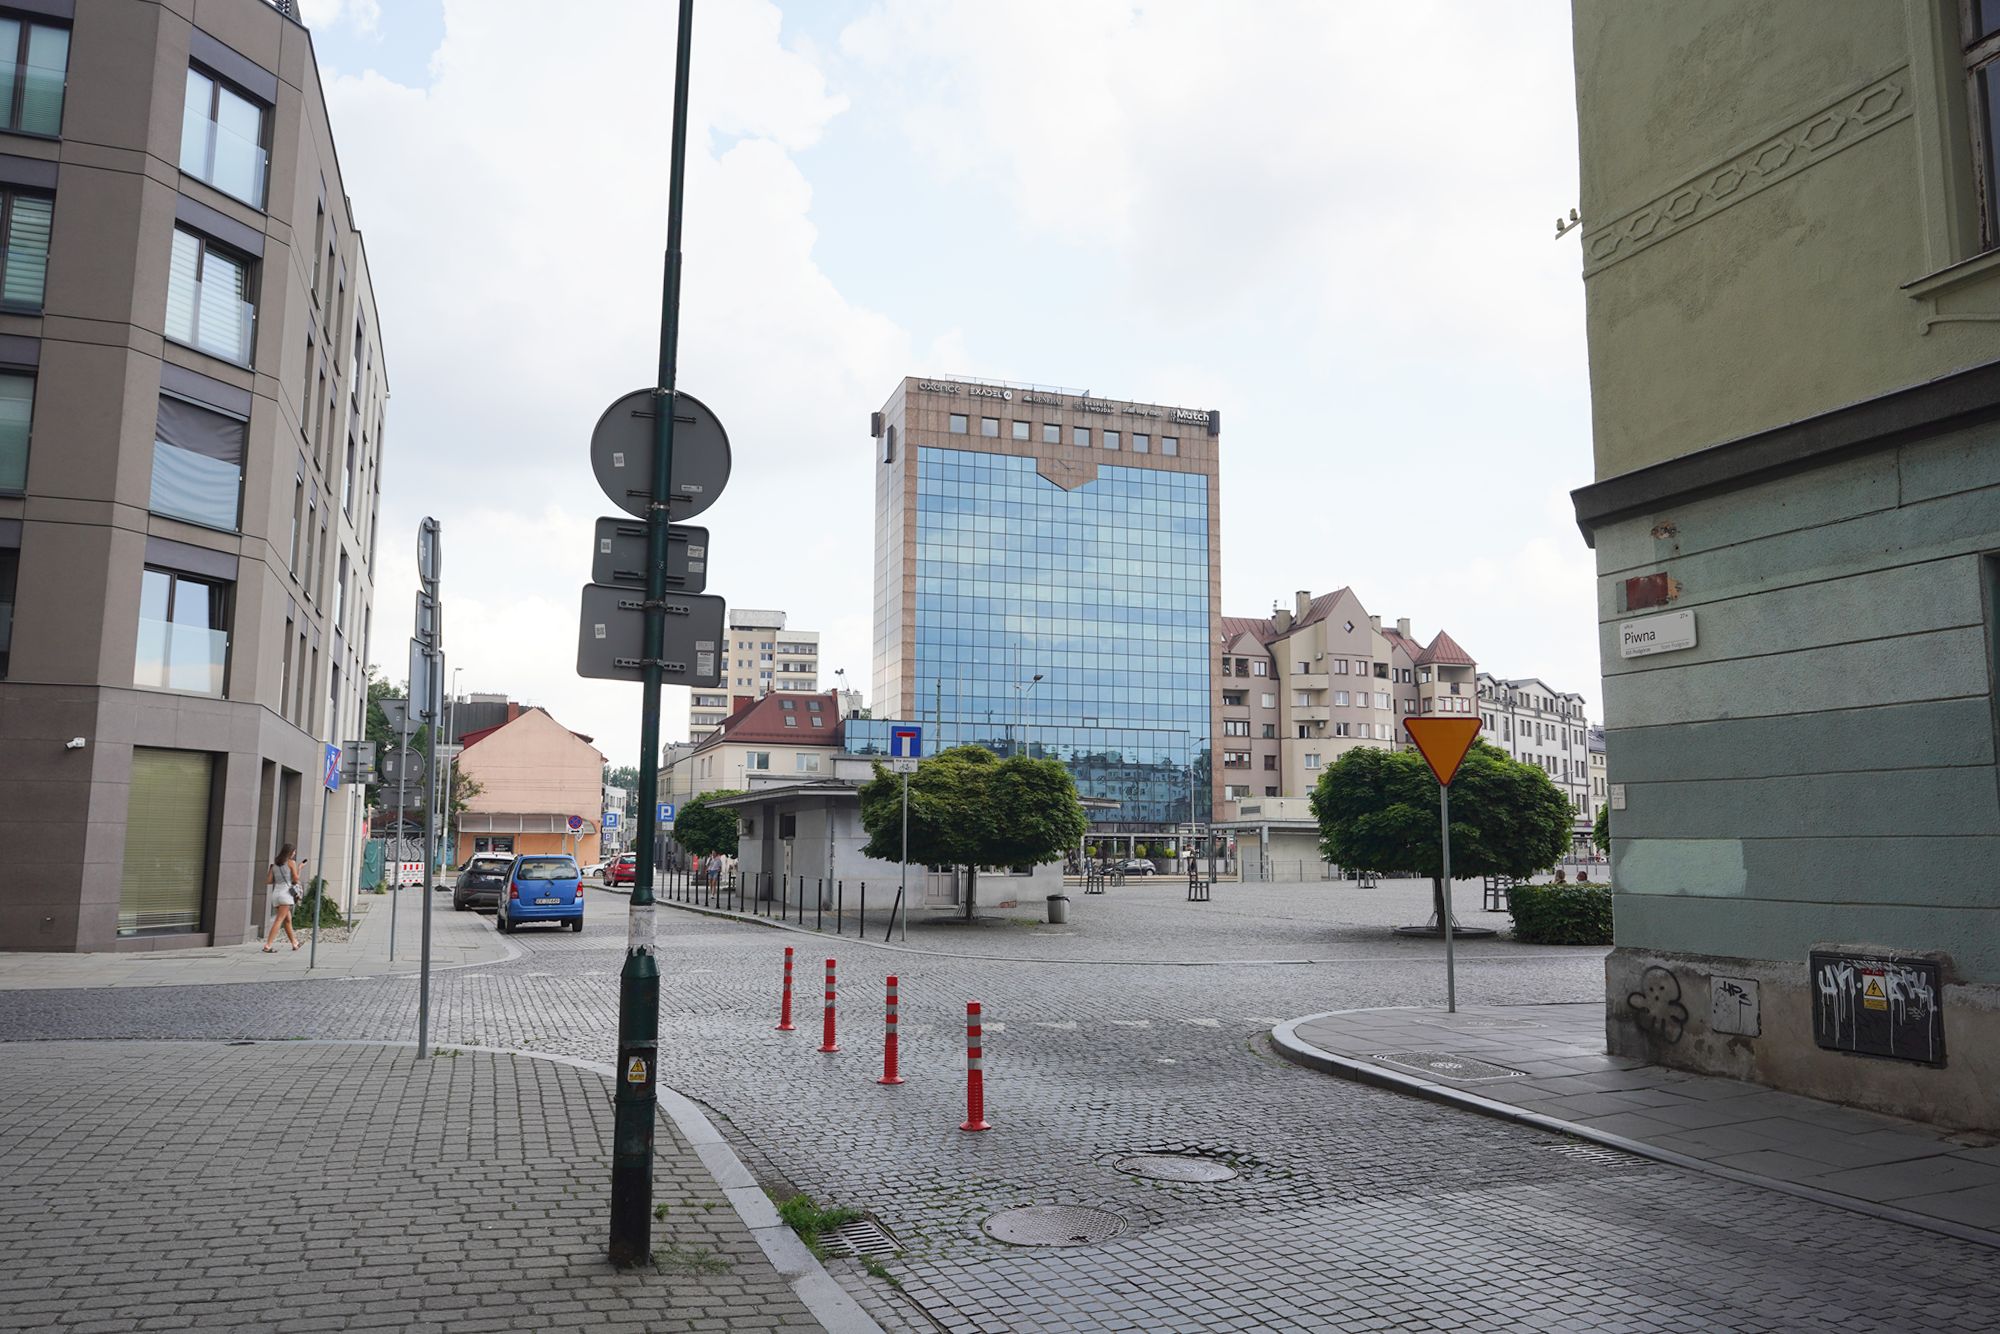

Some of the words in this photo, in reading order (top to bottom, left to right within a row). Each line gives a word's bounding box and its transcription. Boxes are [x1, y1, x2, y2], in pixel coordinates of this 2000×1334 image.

[969, 387, 1003, 398] EXADEL
[1177, 408, 1210, 421] Match
[1624, 630, 1656, 645] Piwna
